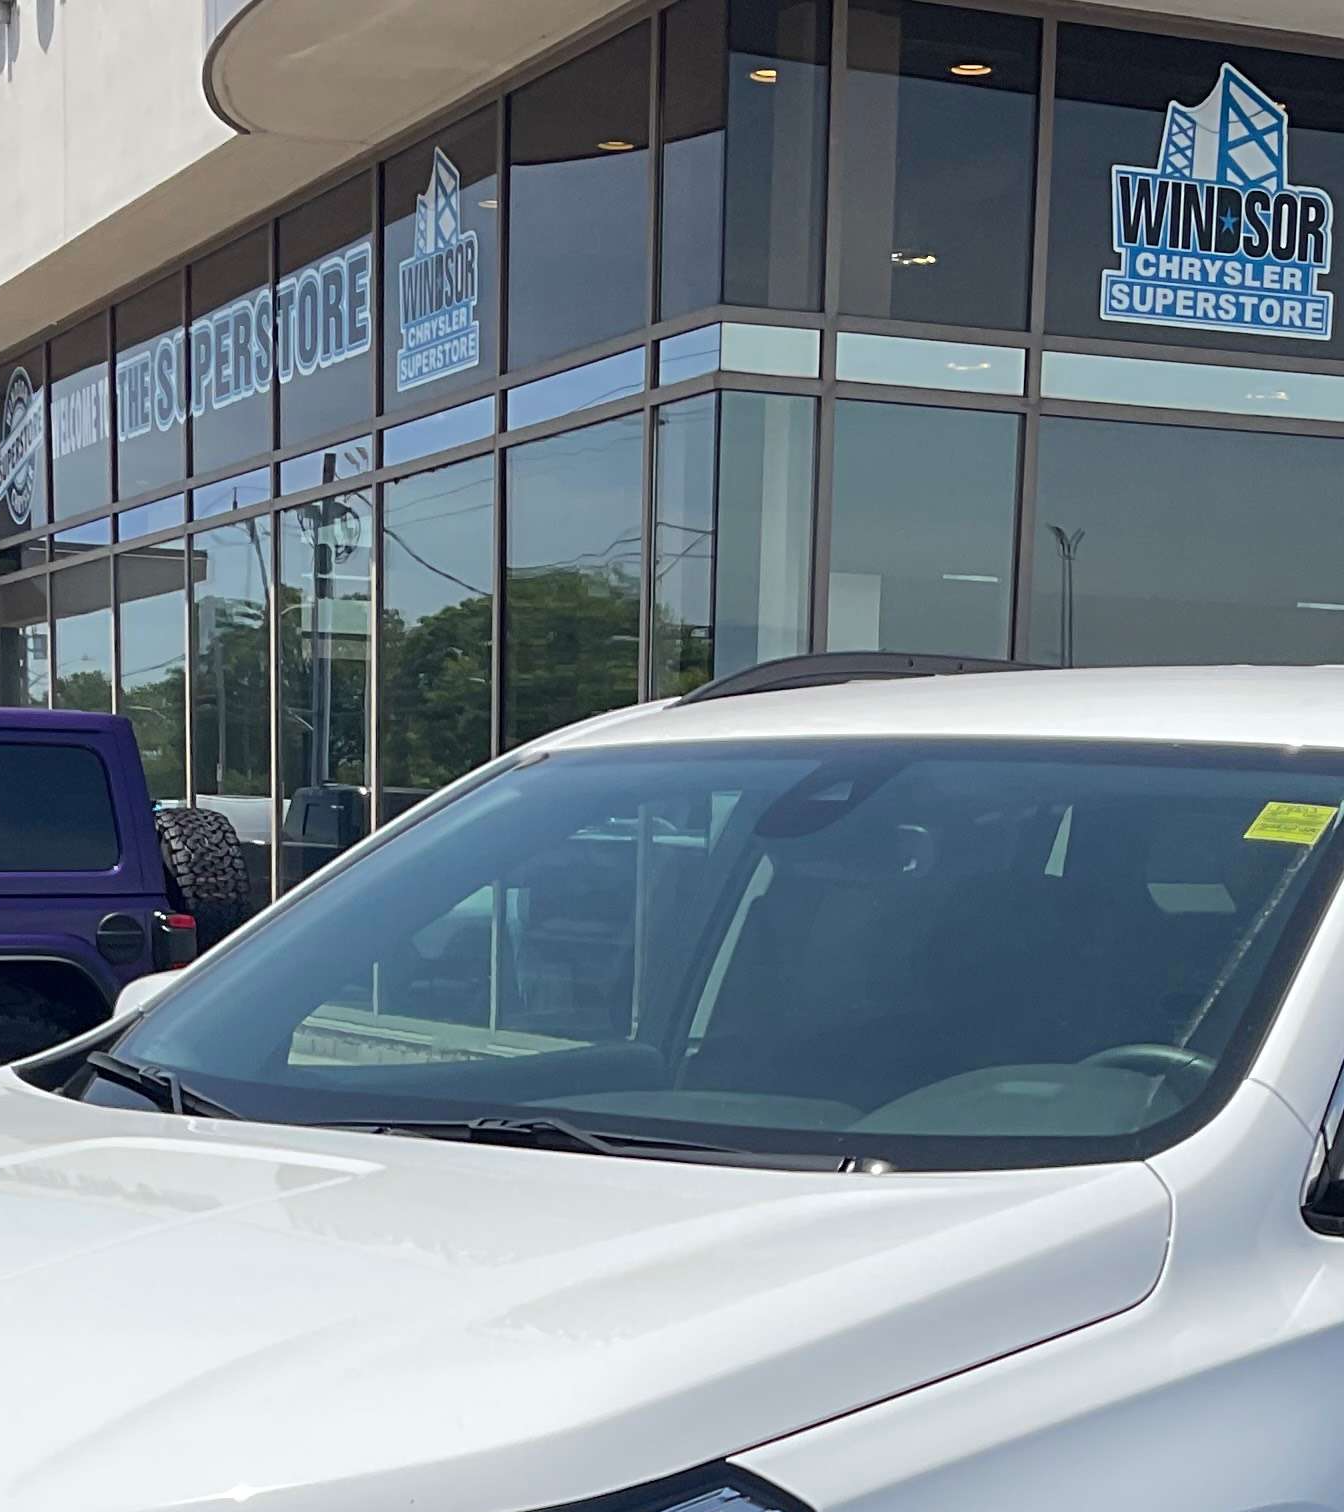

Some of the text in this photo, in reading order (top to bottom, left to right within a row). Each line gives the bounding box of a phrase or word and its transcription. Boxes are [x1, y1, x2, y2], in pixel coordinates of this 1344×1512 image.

[1118, 175, 1326, 265] WINDSOR
[400, 242, 476, 323] WINDSOR
[1135, 252, 1303, 291] CHRYSLER
[407, 309, 468, 348] CHRYSLER
[1110, 283, 1325, 329] SUPERSTORE
[51, 383, 97, 461] WELCOME
[117, 355, 151, 438] THE
[158, 247, 370, 430] SUPERSTORE
[400, 337, 477, 377] SUPERSTORE
